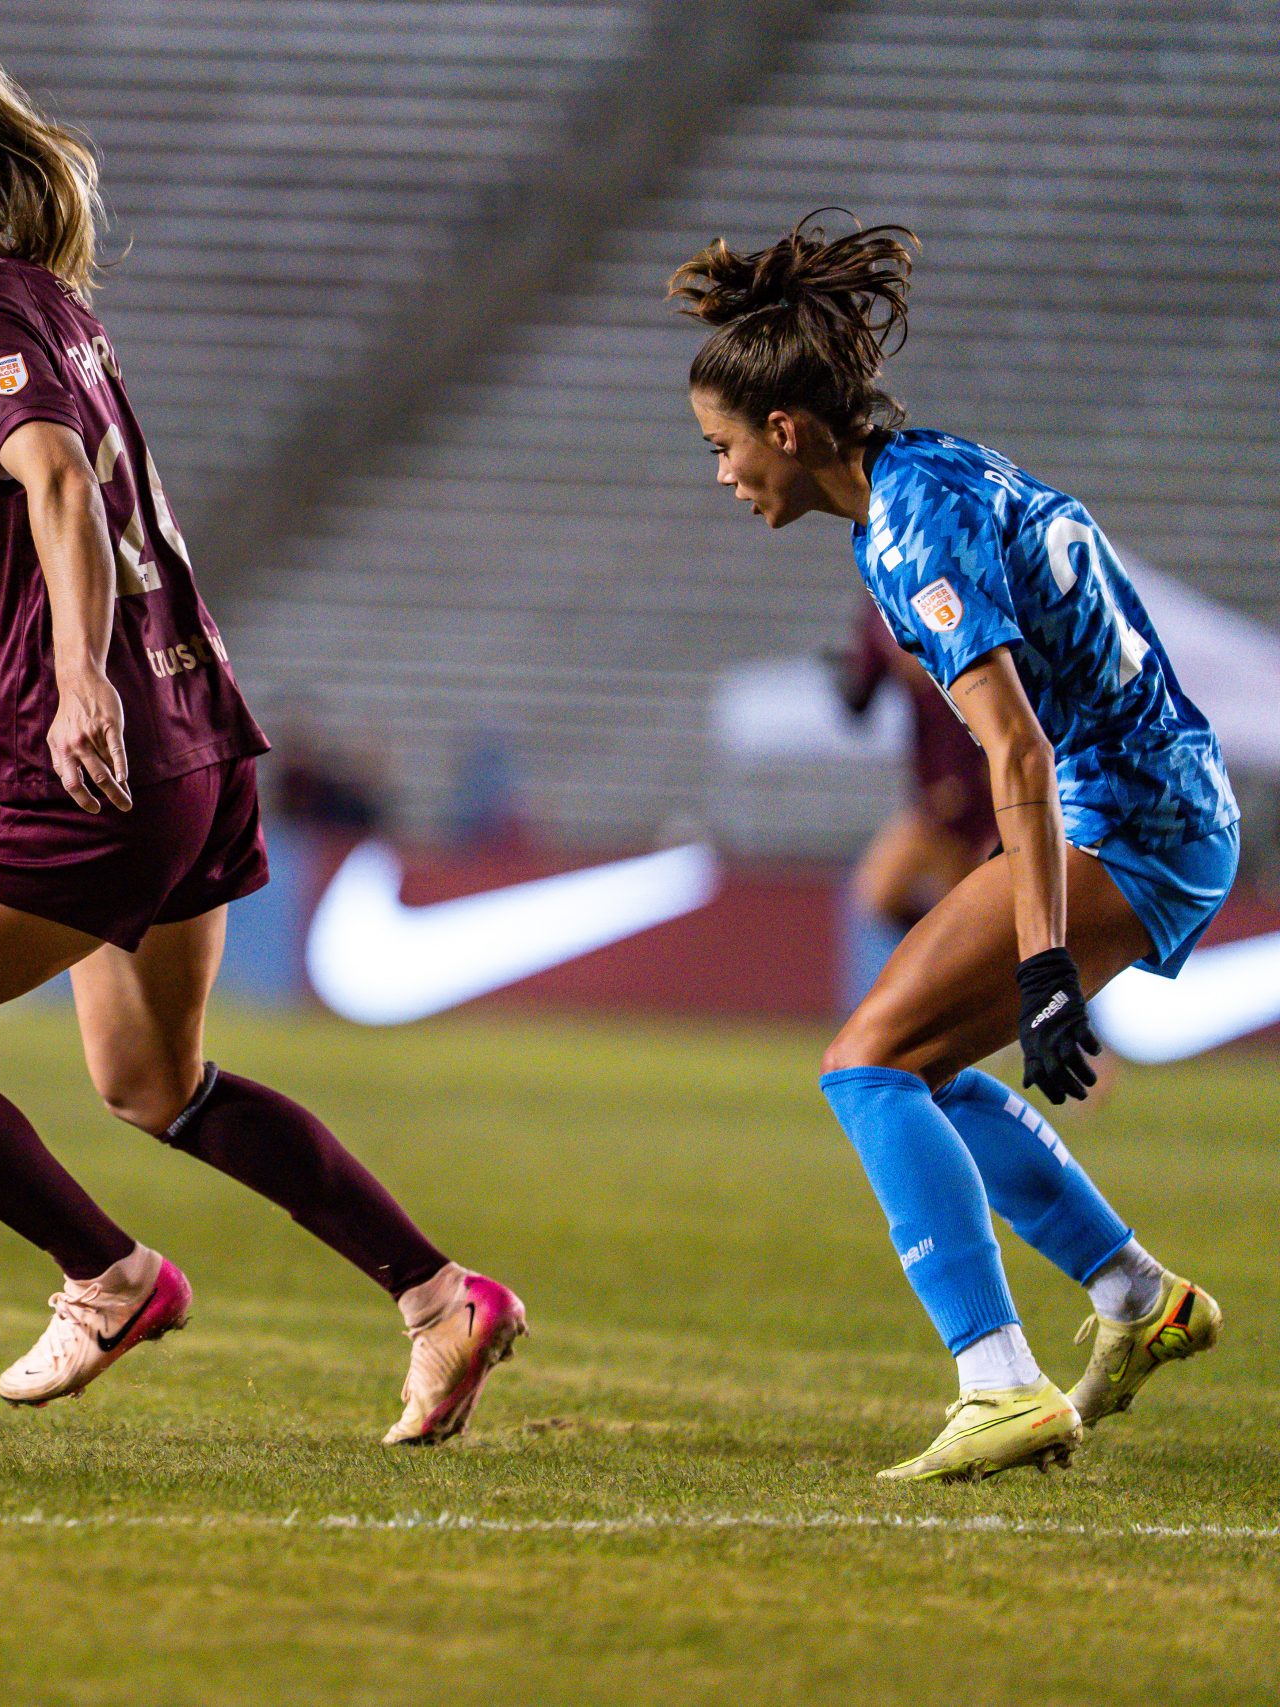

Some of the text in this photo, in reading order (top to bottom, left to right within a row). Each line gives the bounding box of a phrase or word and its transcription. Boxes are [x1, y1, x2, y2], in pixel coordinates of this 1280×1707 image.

[4, 379, 13, 387] S
[921, 588, 948, 609] SUPER
[924, 593, 952, 617] LEAGUE
[940, 609, 950, 620] S
[1031, 990, 1069, 1028] capelli
